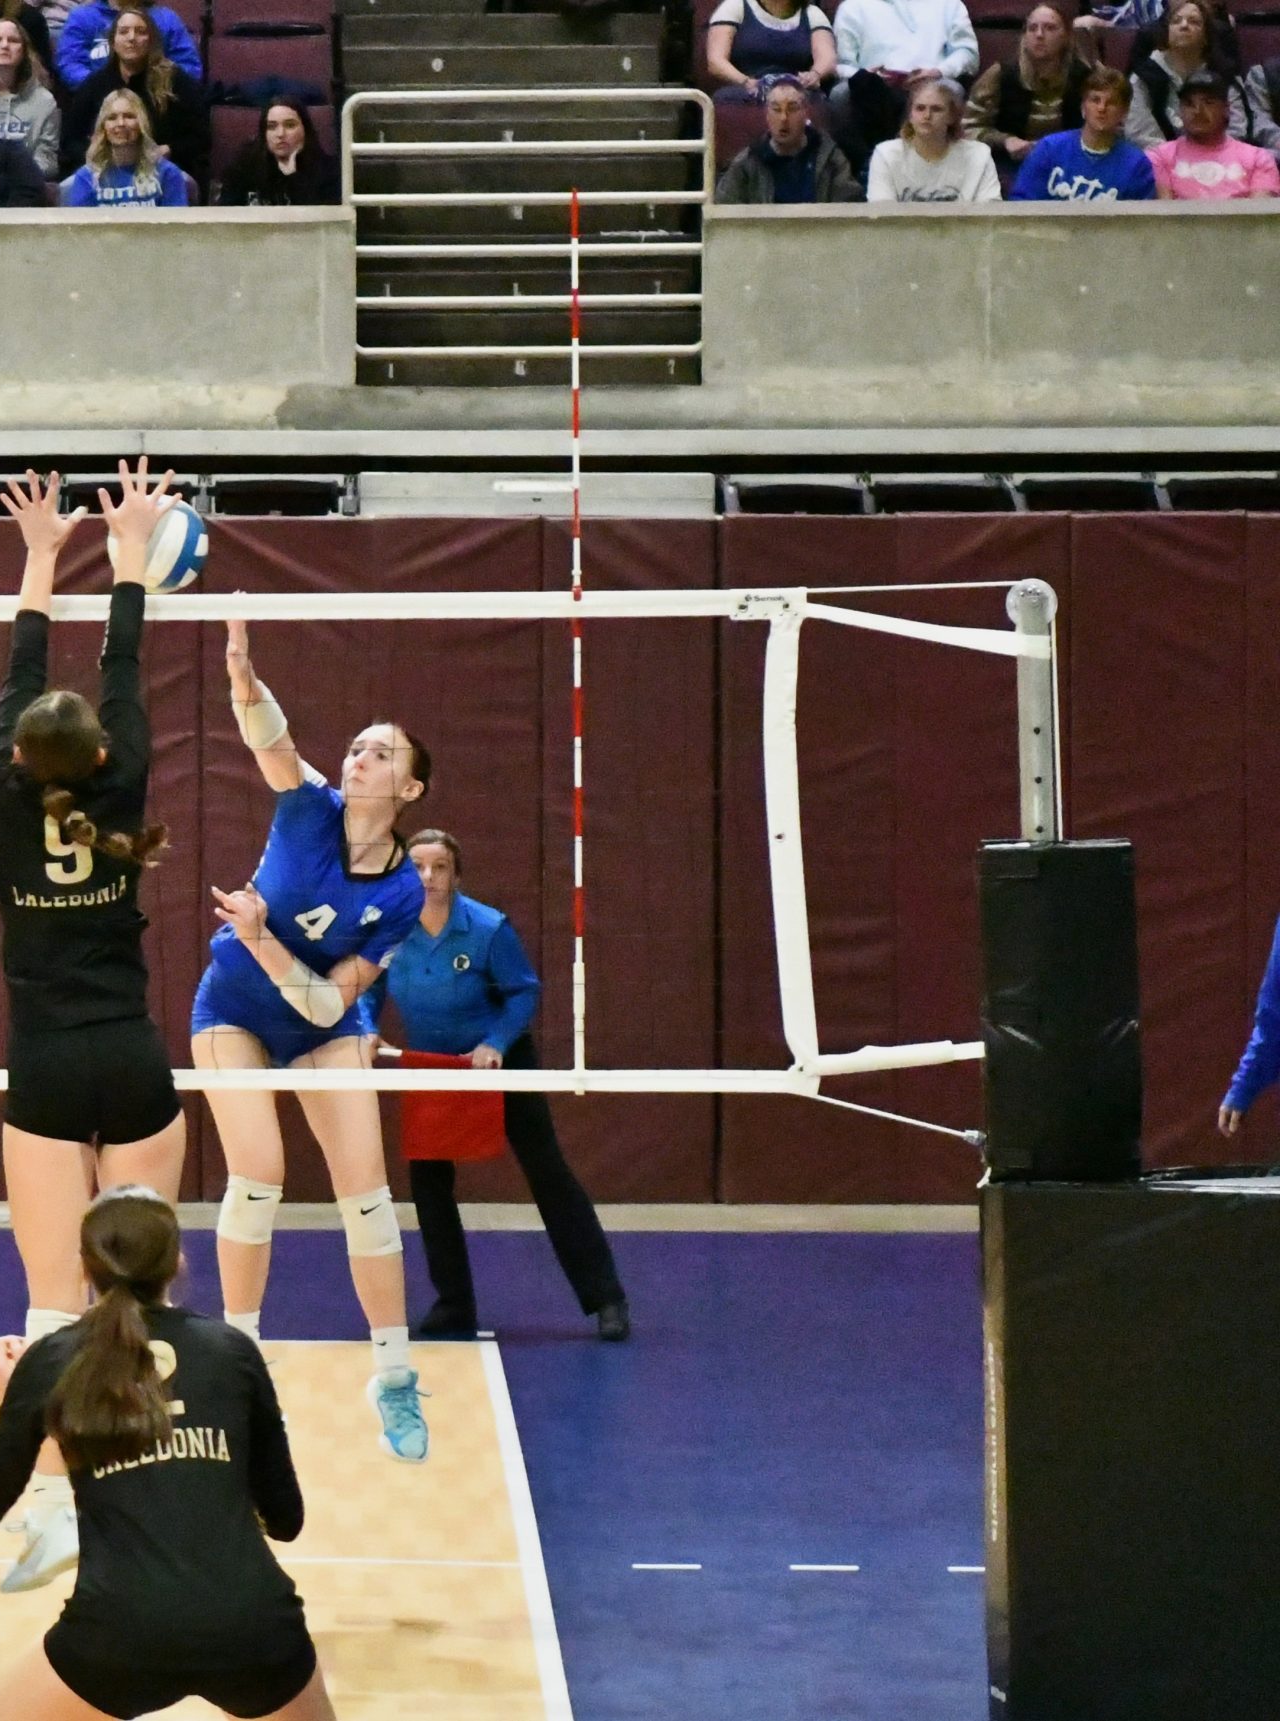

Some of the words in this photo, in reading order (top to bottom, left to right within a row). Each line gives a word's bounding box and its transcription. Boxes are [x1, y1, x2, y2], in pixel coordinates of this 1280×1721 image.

[44, 811, 94, 884] 9
[294, 903, 338, 941] 4
[93, 1426, 232, 1480] DONIA
